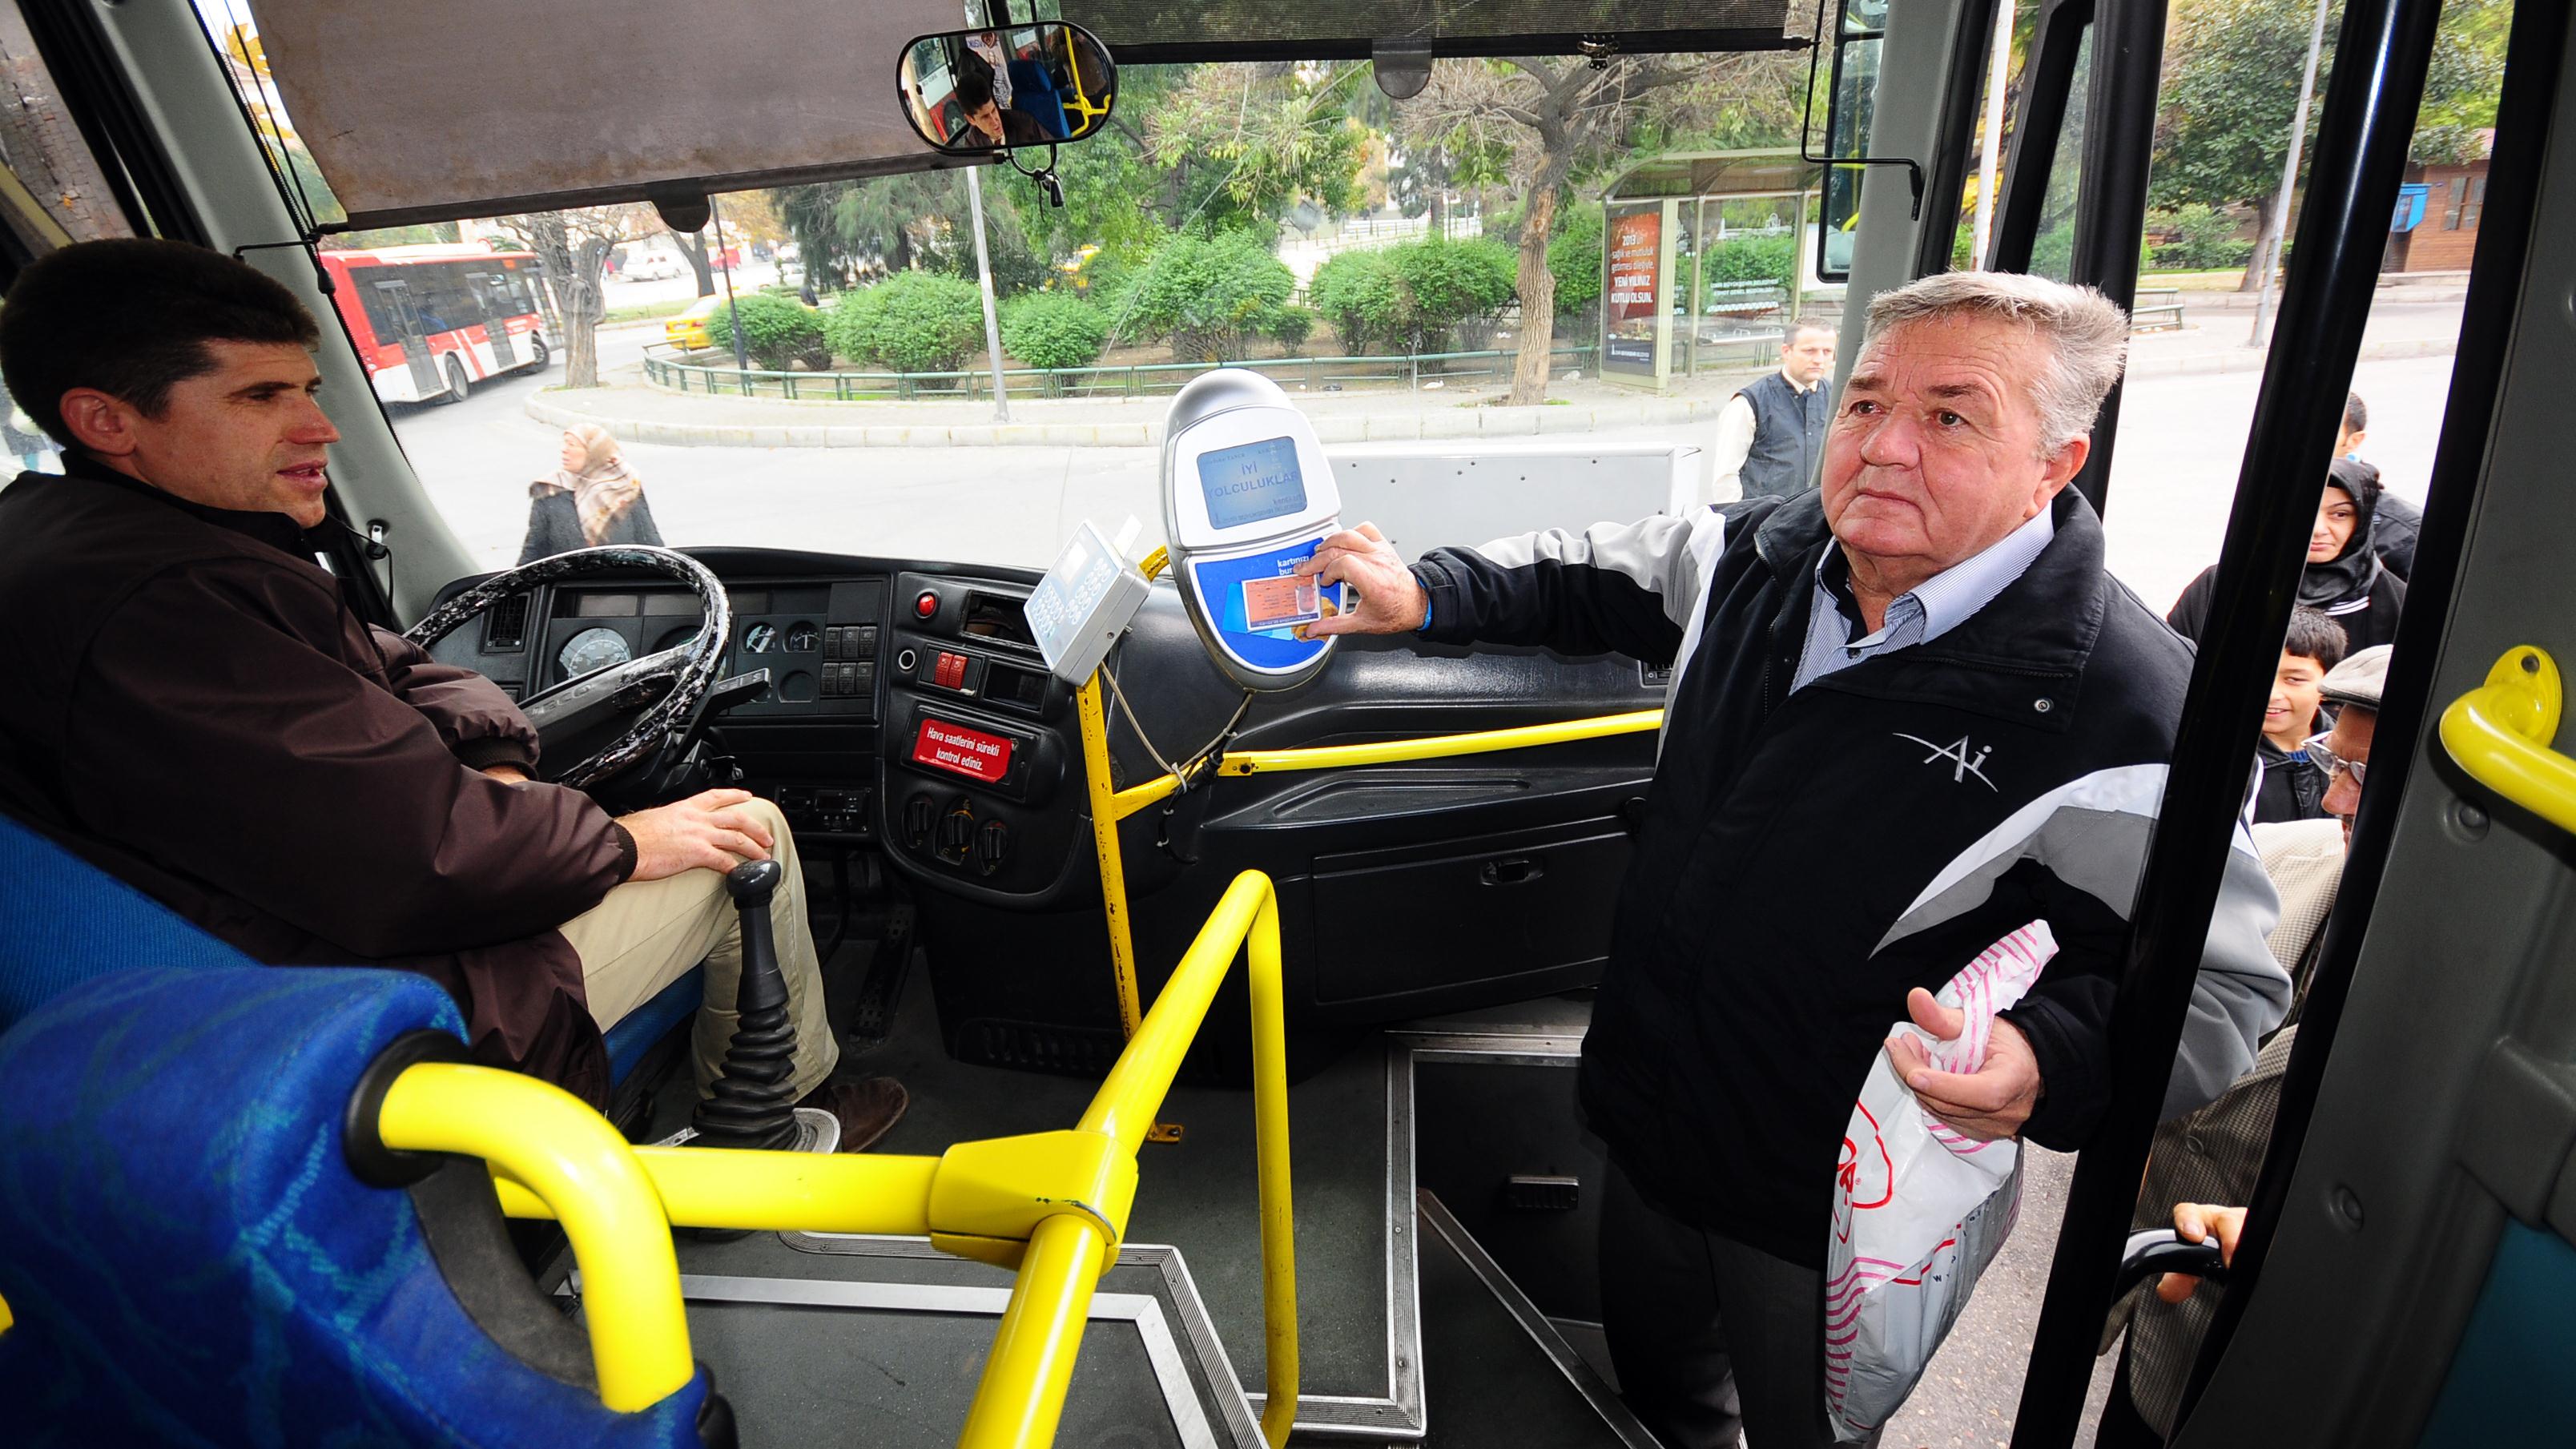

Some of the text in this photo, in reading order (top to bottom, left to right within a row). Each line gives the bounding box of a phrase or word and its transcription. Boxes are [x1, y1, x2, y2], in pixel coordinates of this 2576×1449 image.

[1611, 292, 1630, 304] KUTLU
[927, 727, 1000, 757] Hava saatlerini sürekli
[936, 747, 960, 763] kontrol
